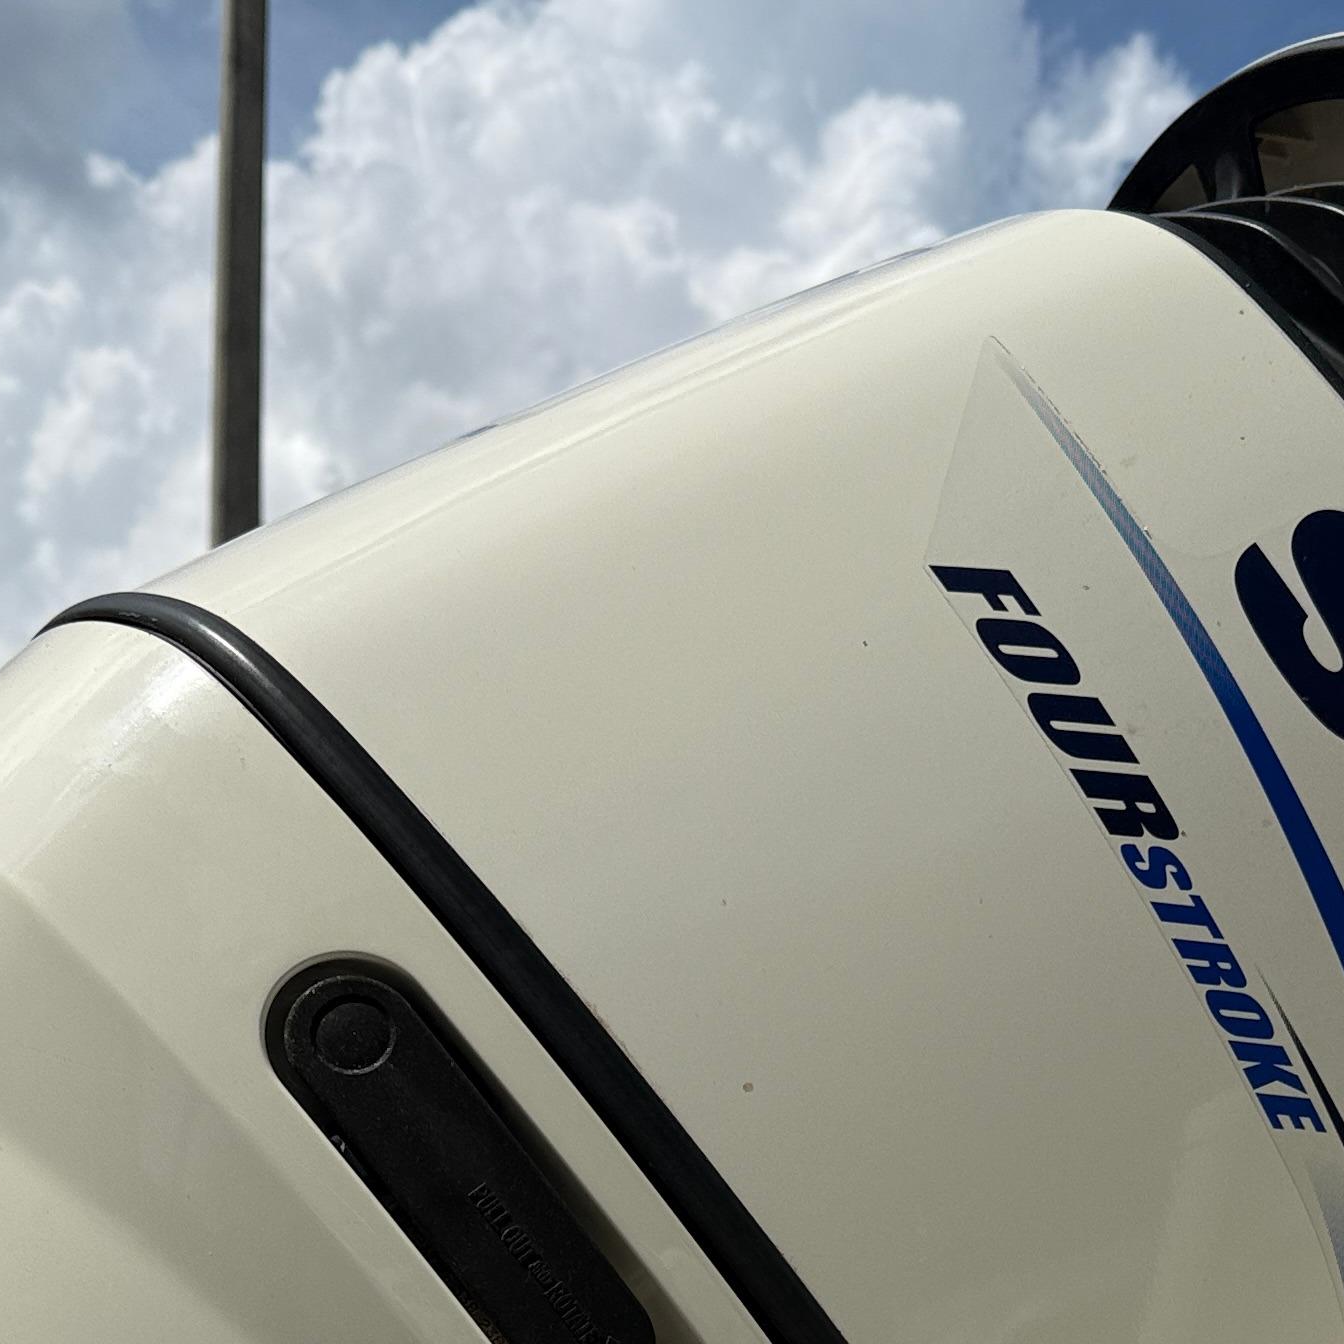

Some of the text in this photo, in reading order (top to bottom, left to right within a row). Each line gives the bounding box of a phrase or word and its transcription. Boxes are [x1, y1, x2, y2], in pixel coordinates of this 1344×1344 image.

[927, 564, 1327, 1133] FOURSTROKE
[466, 1181, 513, 1233] PULL
[501, 1224, 536, 1263] OUT
